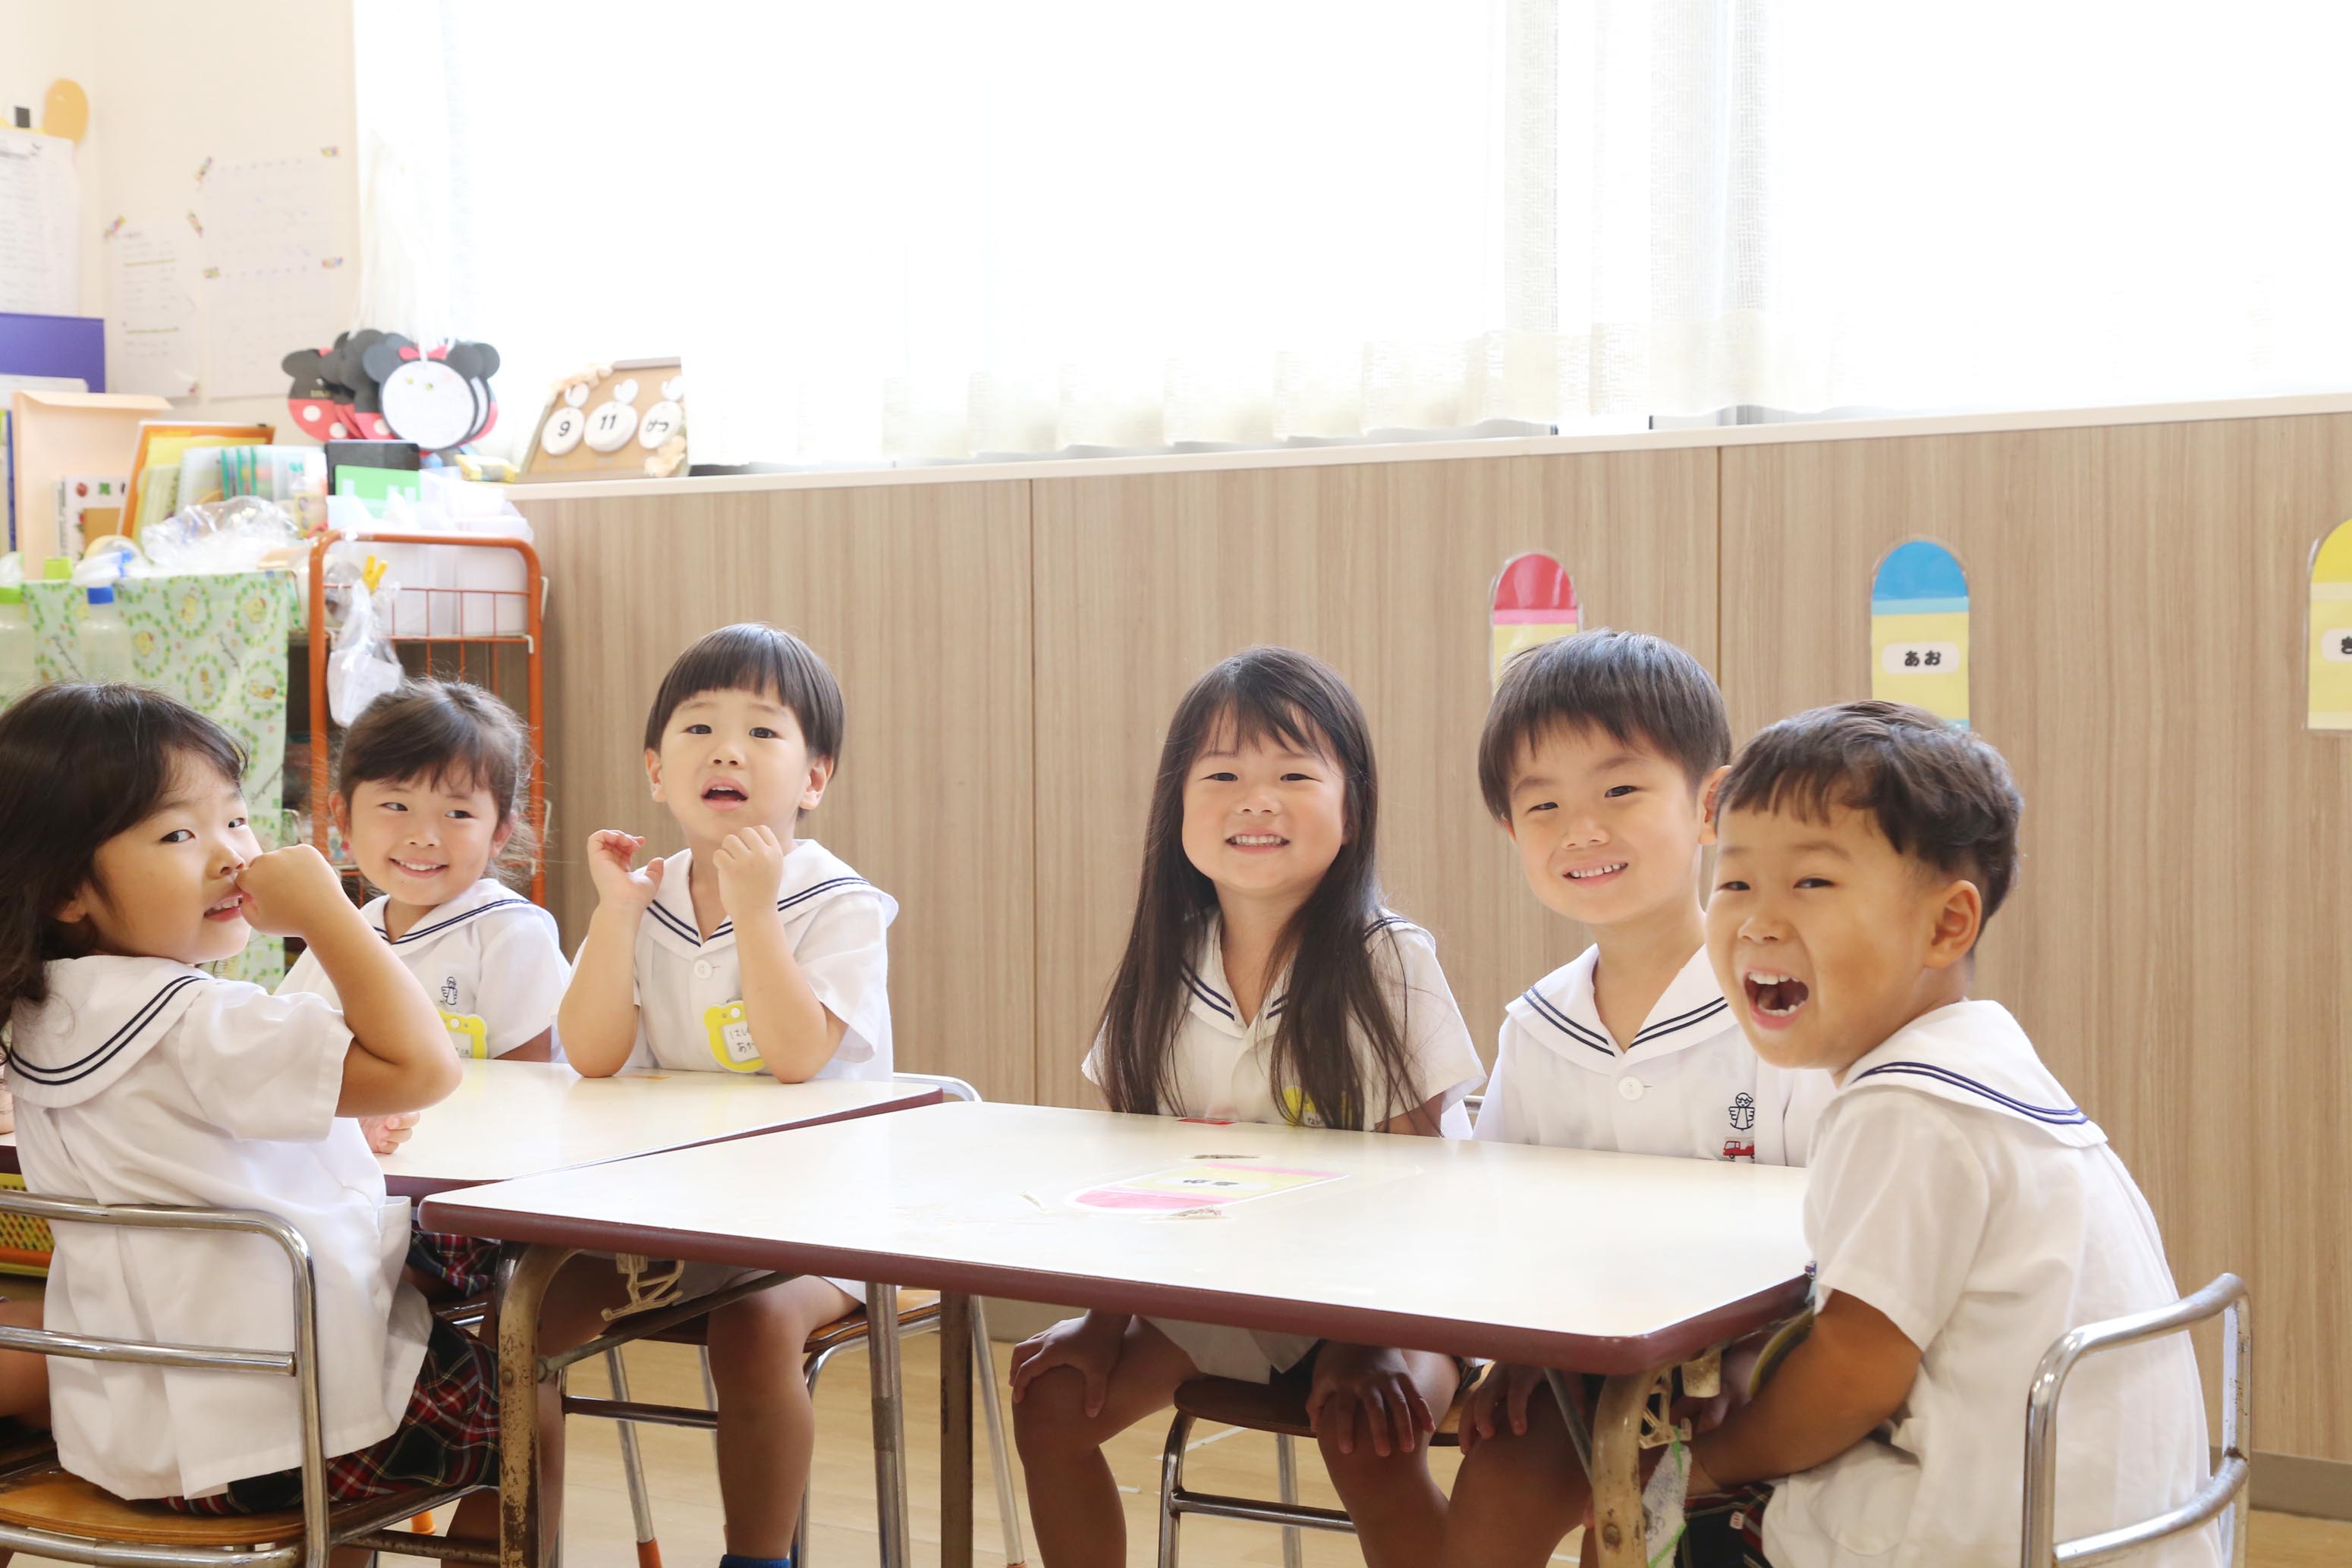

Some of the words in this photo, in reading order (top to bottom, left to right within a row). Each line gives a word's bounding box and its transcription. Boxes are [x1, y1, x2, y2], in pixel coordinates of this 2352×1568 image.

[558, 421, 571, 437] 9
[600, 414, 617, 430] 11
[1904, 650, 1942, 667] あお
